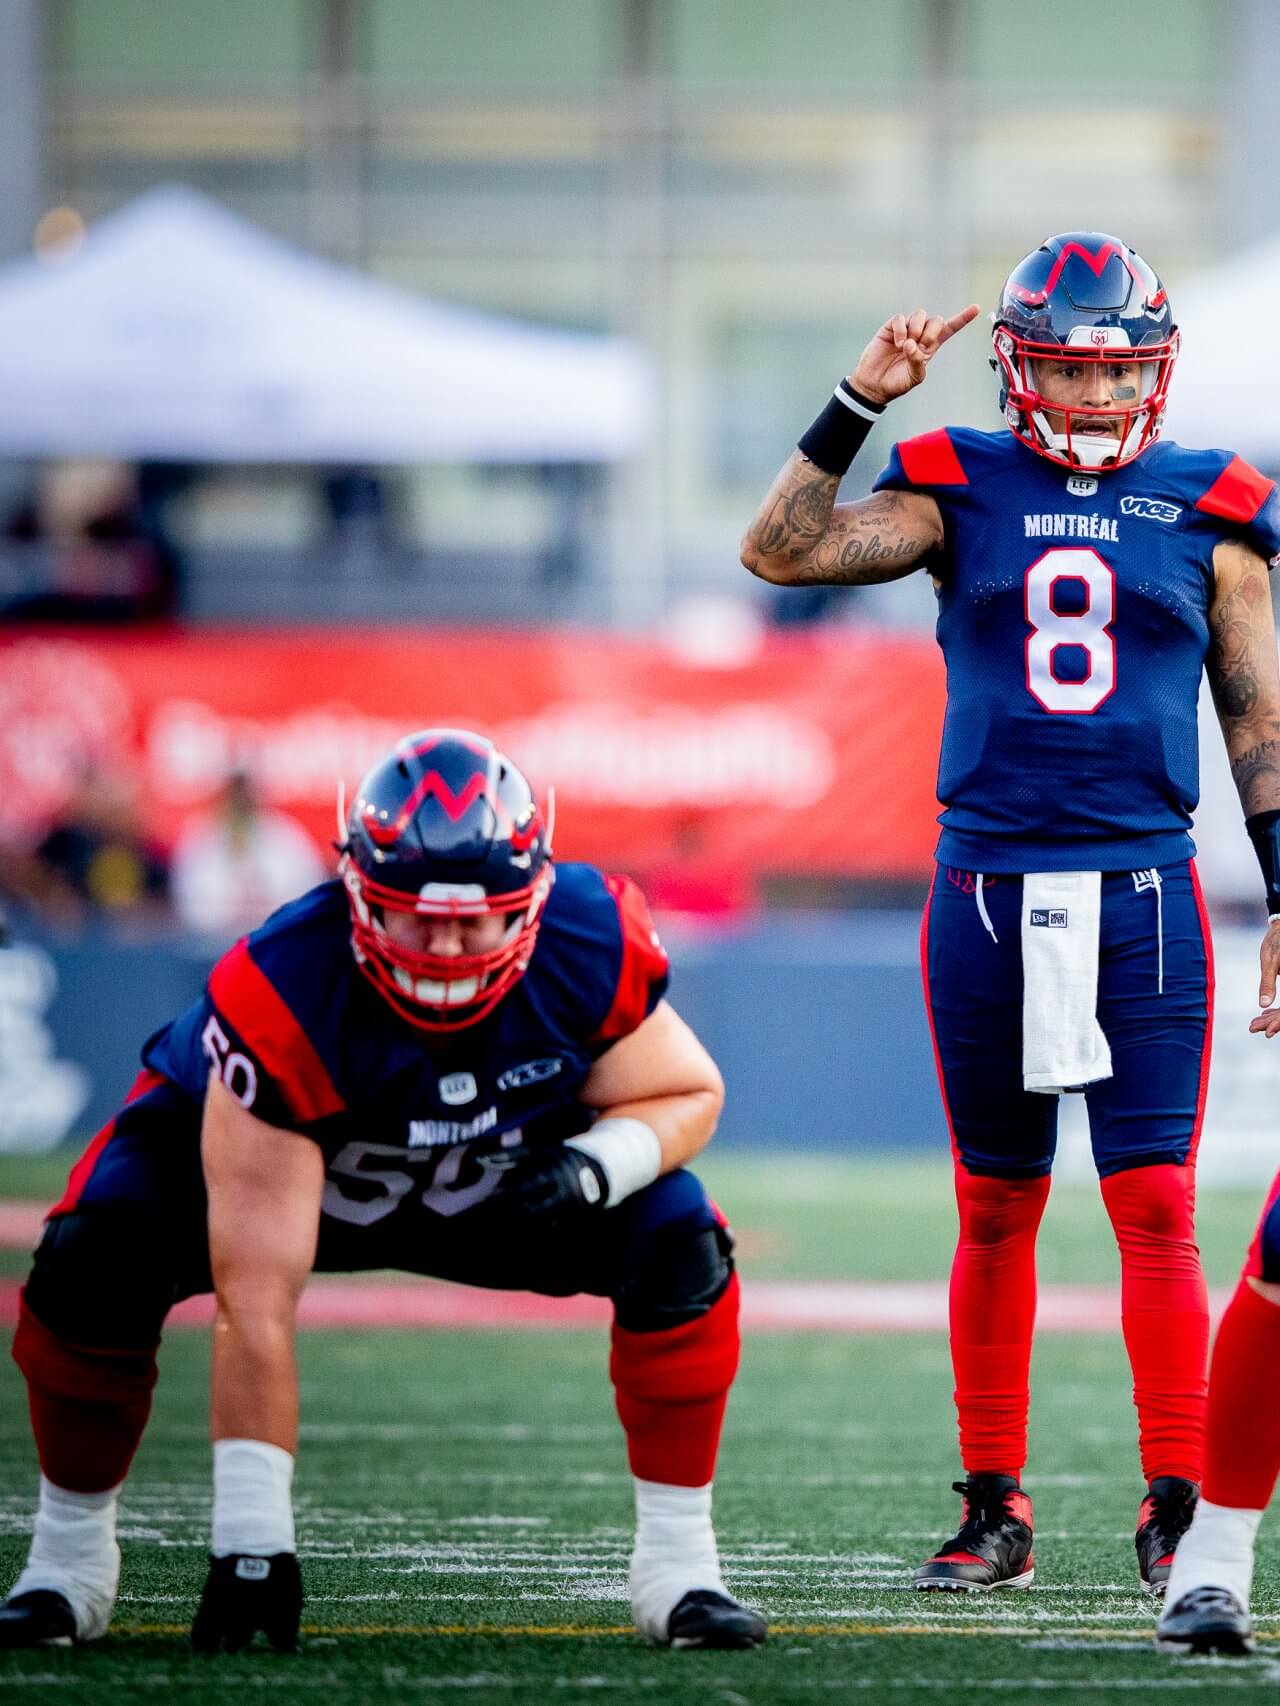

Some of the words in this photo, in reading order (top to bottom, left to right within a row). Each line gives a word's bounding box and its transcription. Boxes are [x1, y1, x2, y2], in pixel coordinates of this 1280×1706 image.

[1071, 480, 1093, 491] LCF
[1119, 496, 1183, 523] VICE
[1023, 512, 1120, 542] MONTRÉAL
[839, 533, 921, 567] Olivia
[1024, 546, 1117, 715] 8
[202, 1014, 258, 1110] 50
